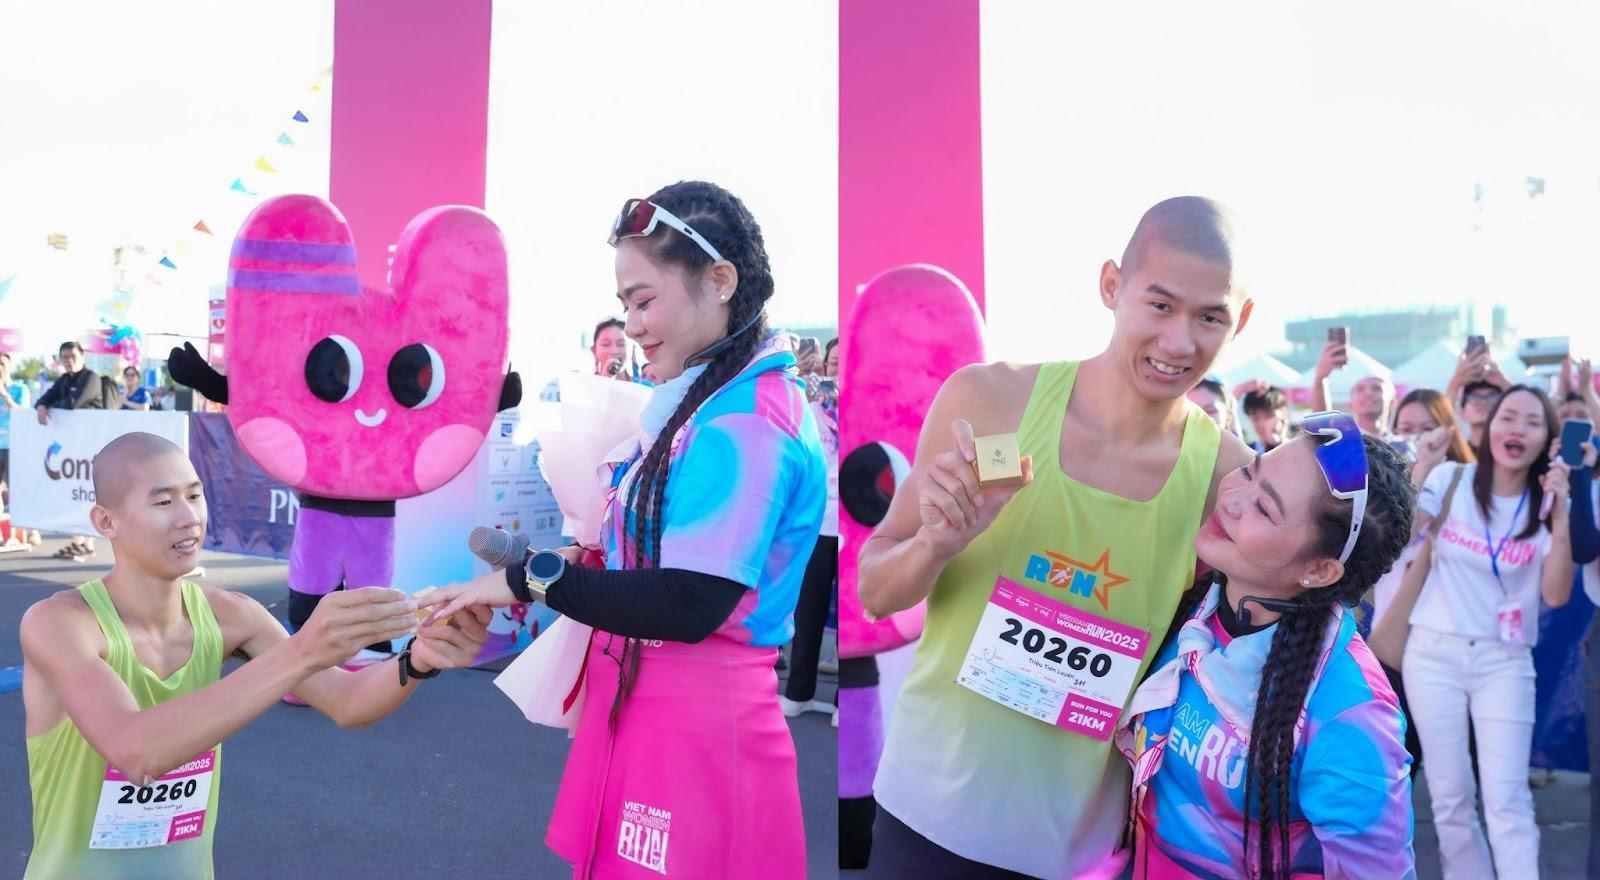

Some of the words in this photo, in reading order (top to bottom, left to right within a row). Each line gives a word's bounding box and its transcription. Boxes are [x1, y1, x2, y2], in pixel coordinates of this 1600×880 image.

[1024, 554, 1097, 598] RUN
[999, 617, 1113, 678] 20260
[1067, 711, 1106, 731] 21KM
[1070, 701, 1085, 710] RUN
[1085, 706, 1099, 714] FOR
[1099, 709, 1113, 718] YOU
[118, 779, 197, 804] 20260
[622, 809, 672, 833] WOMEN
[624, 800, 646, 813] VIET
[648, 806, 672, 820] NAM
[174, 823, 198, 836] 21KM
[617, 819, 669, 875] RUN
